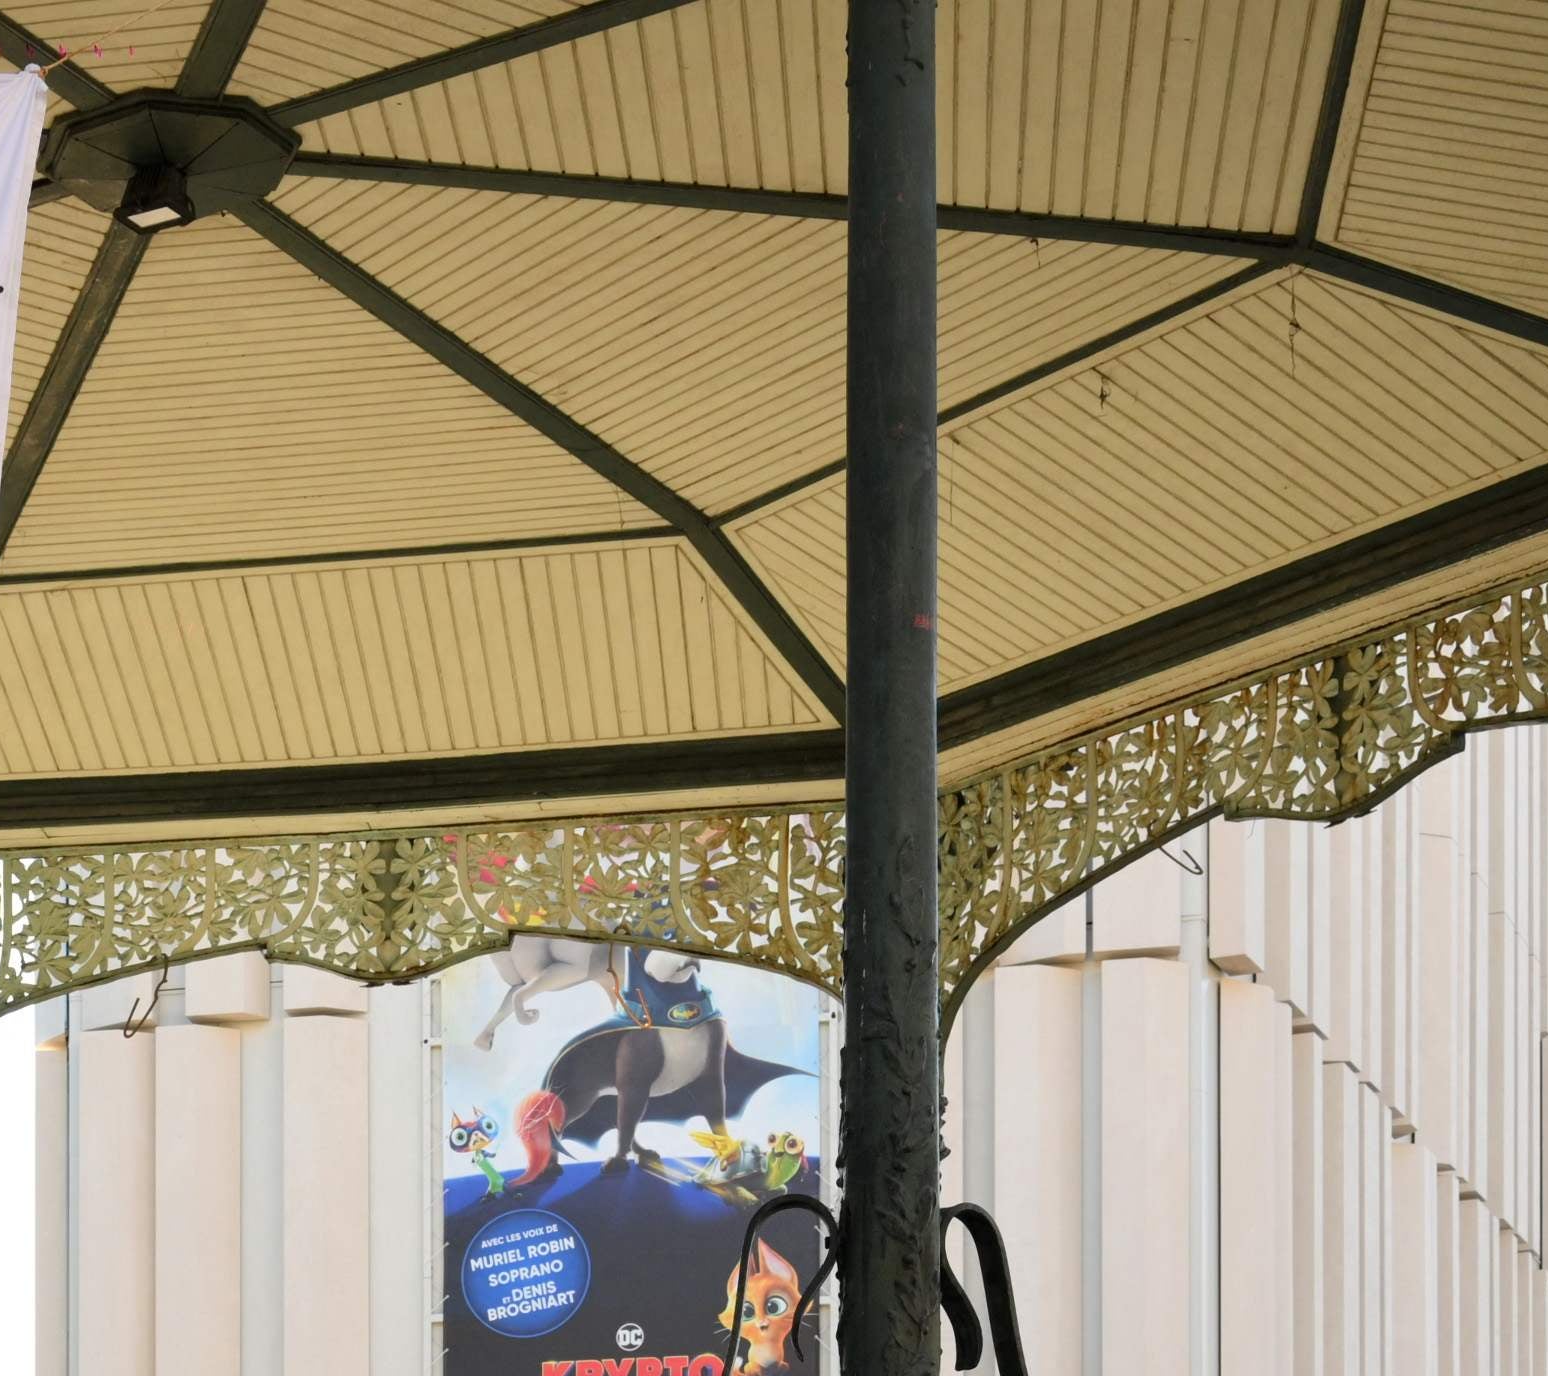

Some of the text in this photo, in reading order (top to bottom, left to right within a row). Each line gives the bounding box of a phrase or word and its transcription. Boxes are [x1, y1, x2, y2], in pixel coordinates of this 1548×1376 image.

[481, 1224, 558, 1248] AVEC LES VOIX DE
[470, 1236, 575, 1272] MURIEL ROBIN
[488, 1259, 564, 1287] SOPRANO
[511, 1281, 557, 1302] DENIS
[487, 1290, 576, 1322] BROGNIART
[617, 1326, 644, 1349] DC
